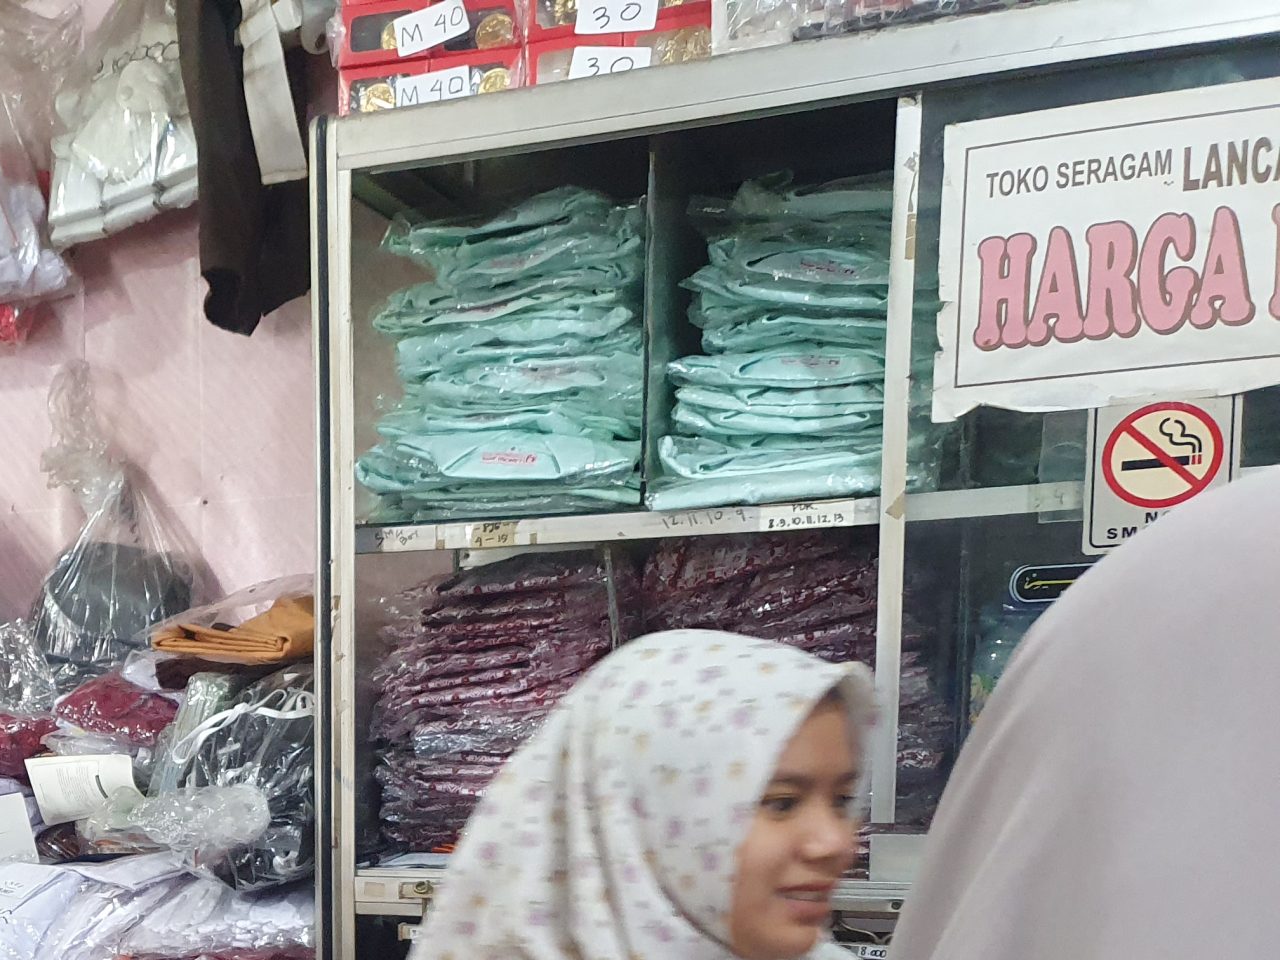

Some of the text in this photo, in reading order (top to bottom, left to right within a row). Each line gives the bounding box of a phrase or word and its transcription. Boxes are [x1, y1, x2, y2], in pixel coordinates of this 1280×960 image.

[401, 6, 464, 48] M 40
[592, 2, 641, 31] 30
[400, 76, 464, 107] M 40
[986, 136, 1280, 198] TOKO SERAGAM LANC
[973, 205, 1256, 352] HARGA
